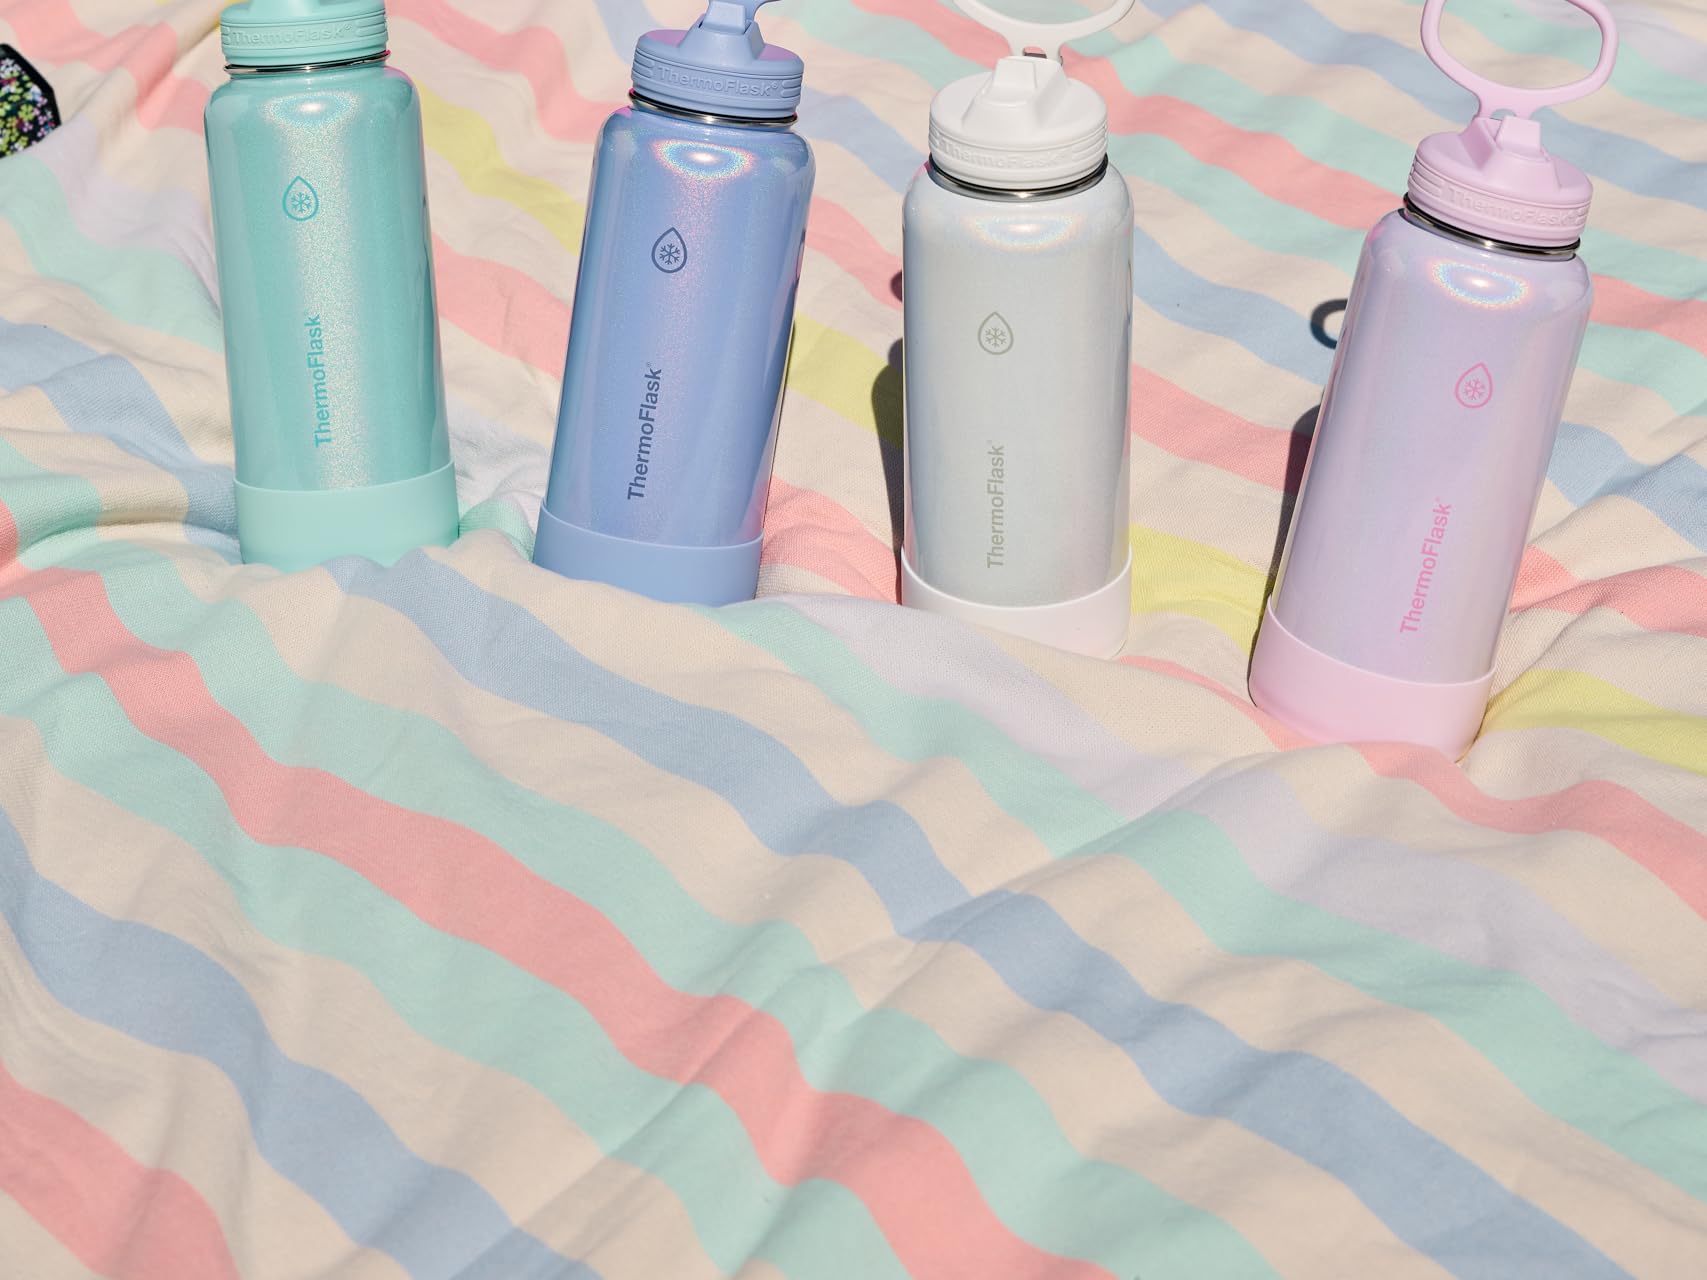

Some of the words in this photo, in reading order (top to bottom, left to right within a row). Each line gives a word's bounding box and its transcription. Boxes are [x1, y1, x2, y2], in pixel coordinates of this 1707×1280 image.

[304, 313, 332, 448] ThermoFlask
[627, 368, 662, 500] ThermoFlask
[986, 445, 1005, 568] ThermoFlask
[1399, 503, 1451, 634] ThermoFlask
